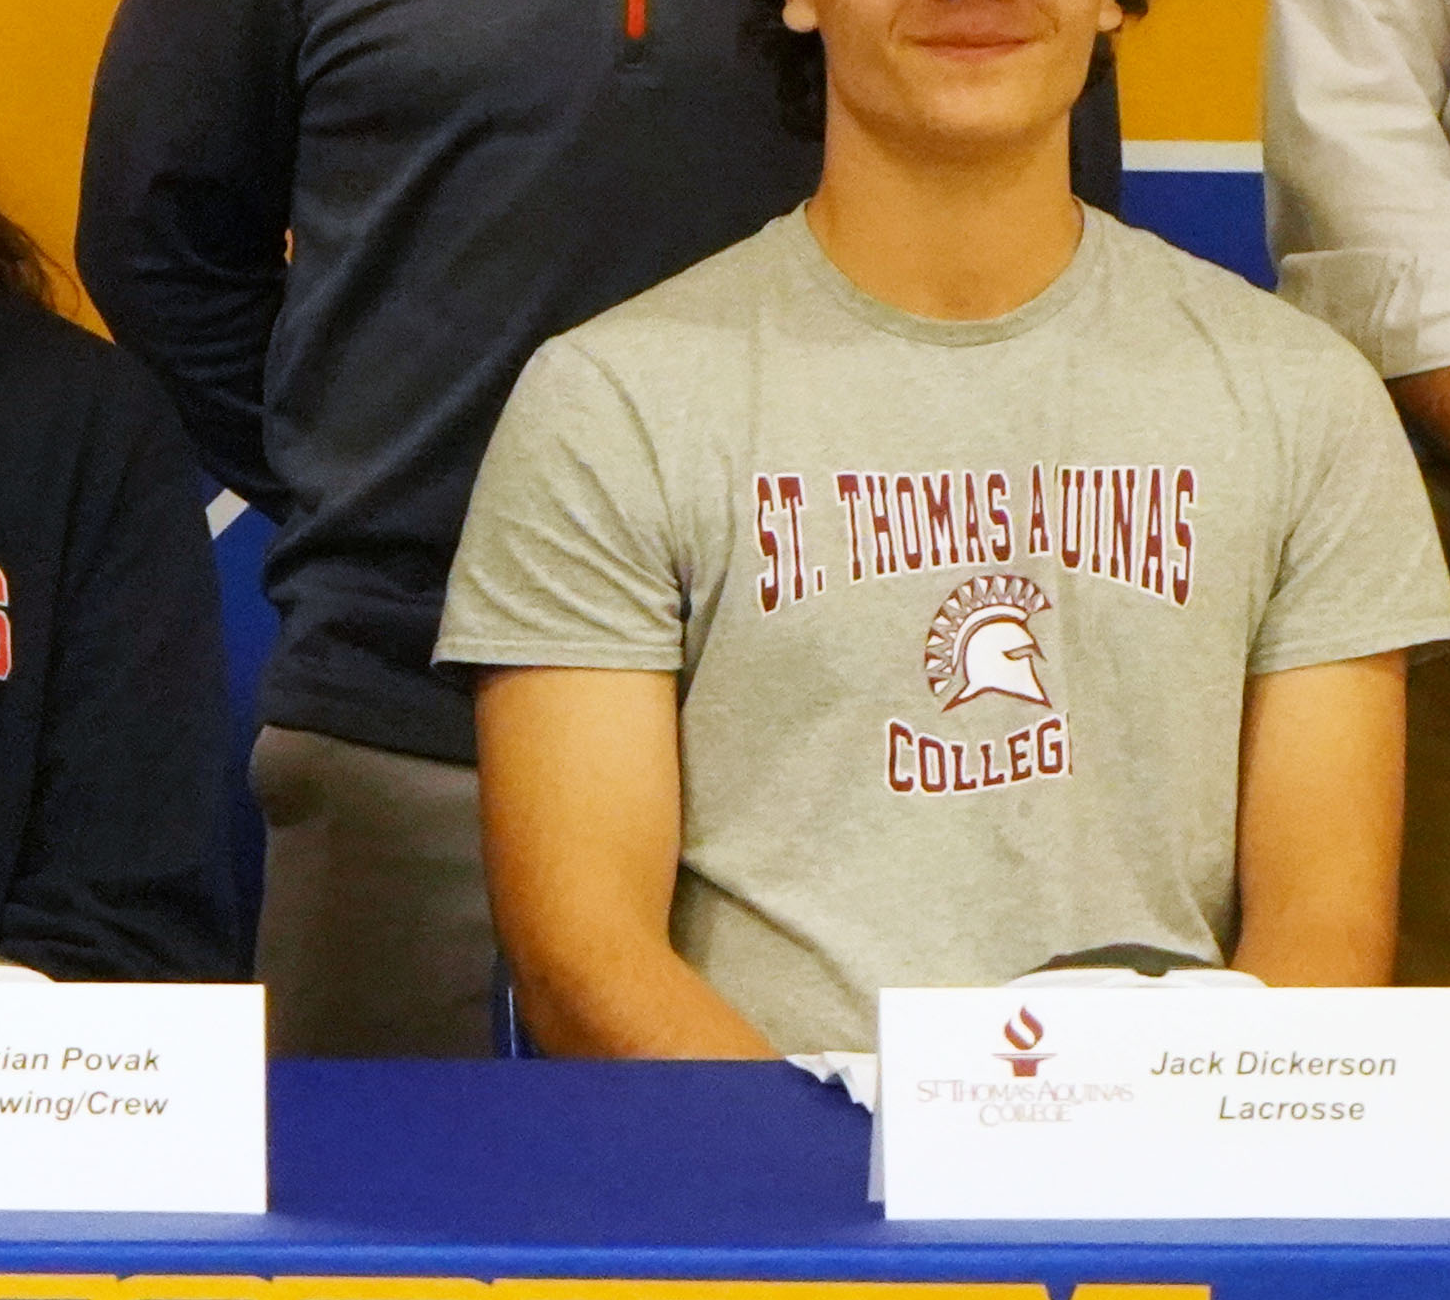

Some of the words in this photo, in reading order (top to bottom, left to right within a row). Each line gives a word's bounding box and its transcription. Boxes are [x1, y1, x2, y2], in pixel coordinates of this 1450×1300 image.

[754, 471, 828, 615] ST.
[833, 469, 1014, 584] THOMAS
[1027, 459, 1198, 609] AUINAS
[884, 711, 1073, 796] COLLEG
[61, 1046, 160, 1072] Povak
[1150, 1050, 1224, 1077] Jack
[1235, 1050, 1397, 1077] Dickerson
[1218, 1096, 1366, 1121] Lacrosse
